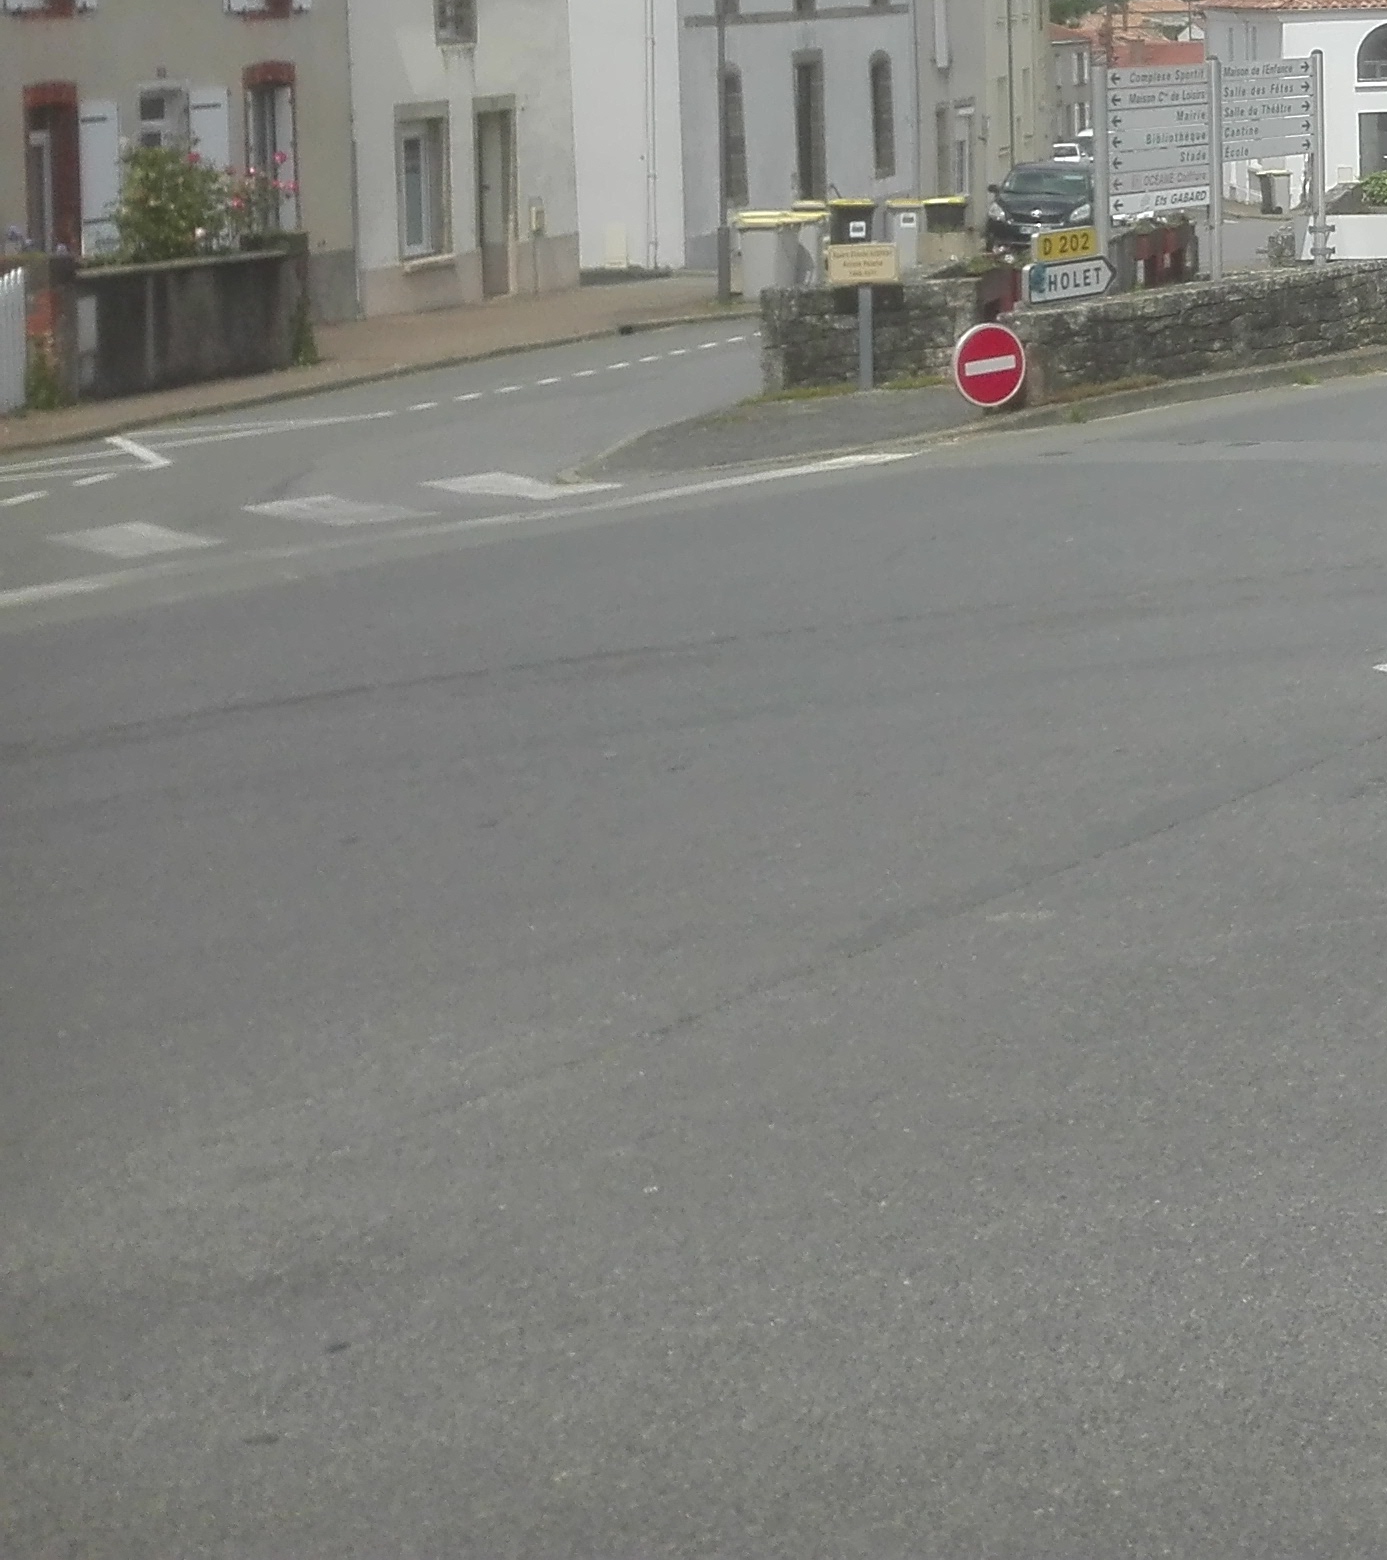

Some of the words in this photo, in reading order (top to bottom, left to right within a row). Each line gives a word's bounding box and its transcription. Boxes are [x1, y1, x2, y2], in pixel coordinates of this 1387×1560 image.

[1129, 71, 1171, 84] Complexe
[1175, 68, 1204, 81] Sportif
[1223, 66, 1249, 77] Maison
[1250, 65, 1260, 76] de
[1129, 92, 1156, 104] Maison
[1171, 91, 1179, 101] de
[1182, 90, 1205, 101] Loisirs
[1224, 86, 1246, 98] Salle
[1250, 85, 1265, 96] des
[1270, 83, 1294, 94] Fêtes
[1176, 109, 1206, 121] Mairie
[1224, 106, 1246, 118] Salle
[1248, 105, 1258, 116] du
[1262, 103, 1292, 114] Théâtre
[1146, 132, 1206, 144] Bibliothèque
[1224, 127, 1259, 138] Cantine
[1180, 150, 1207, 162] Stade
[1154, 195, 1168, 207] Ets
[1170, 190, 1208, 205] GABARD
[1042, 237, 1053, 256] D
[1059, 232, 1090, 254] 202
[1036, 267, 1101, 293] HOLET
